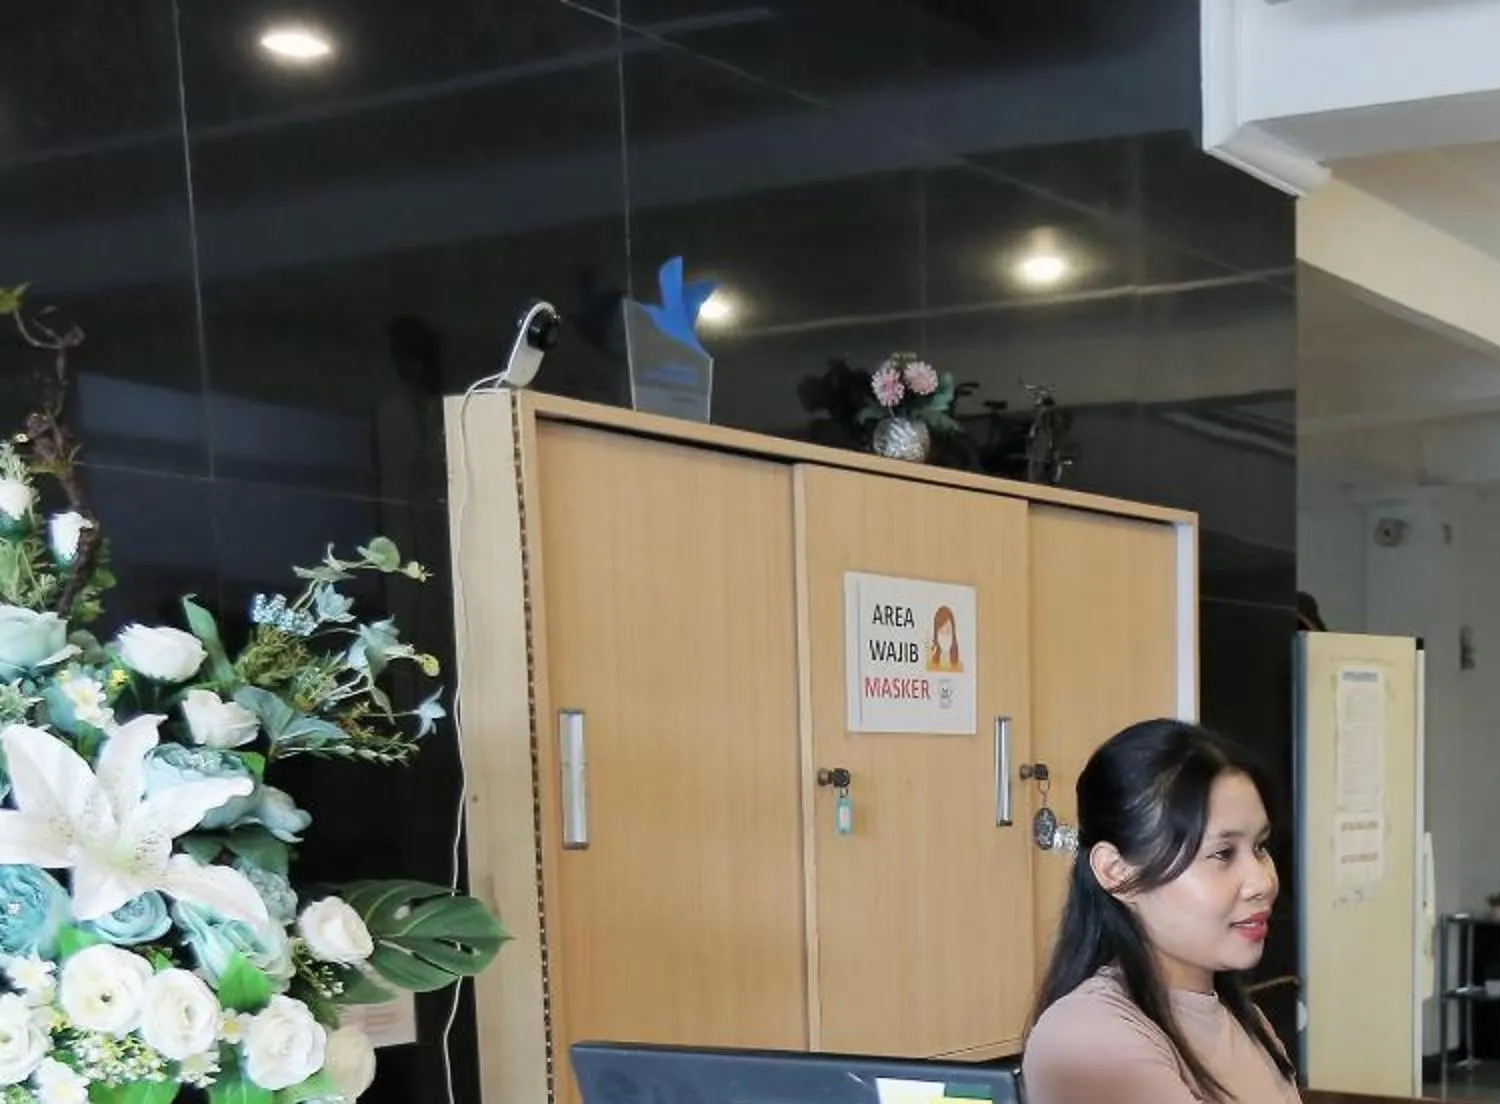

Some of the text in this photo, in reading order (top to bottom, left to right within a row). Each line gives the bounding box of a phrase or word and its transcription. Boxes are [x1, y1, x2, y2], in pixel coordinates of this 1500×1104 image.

[872, 603, 915, 628] AREA
[869, 639, 919, 663] WAJIB
[864, 677, 930, 700] MASKER
